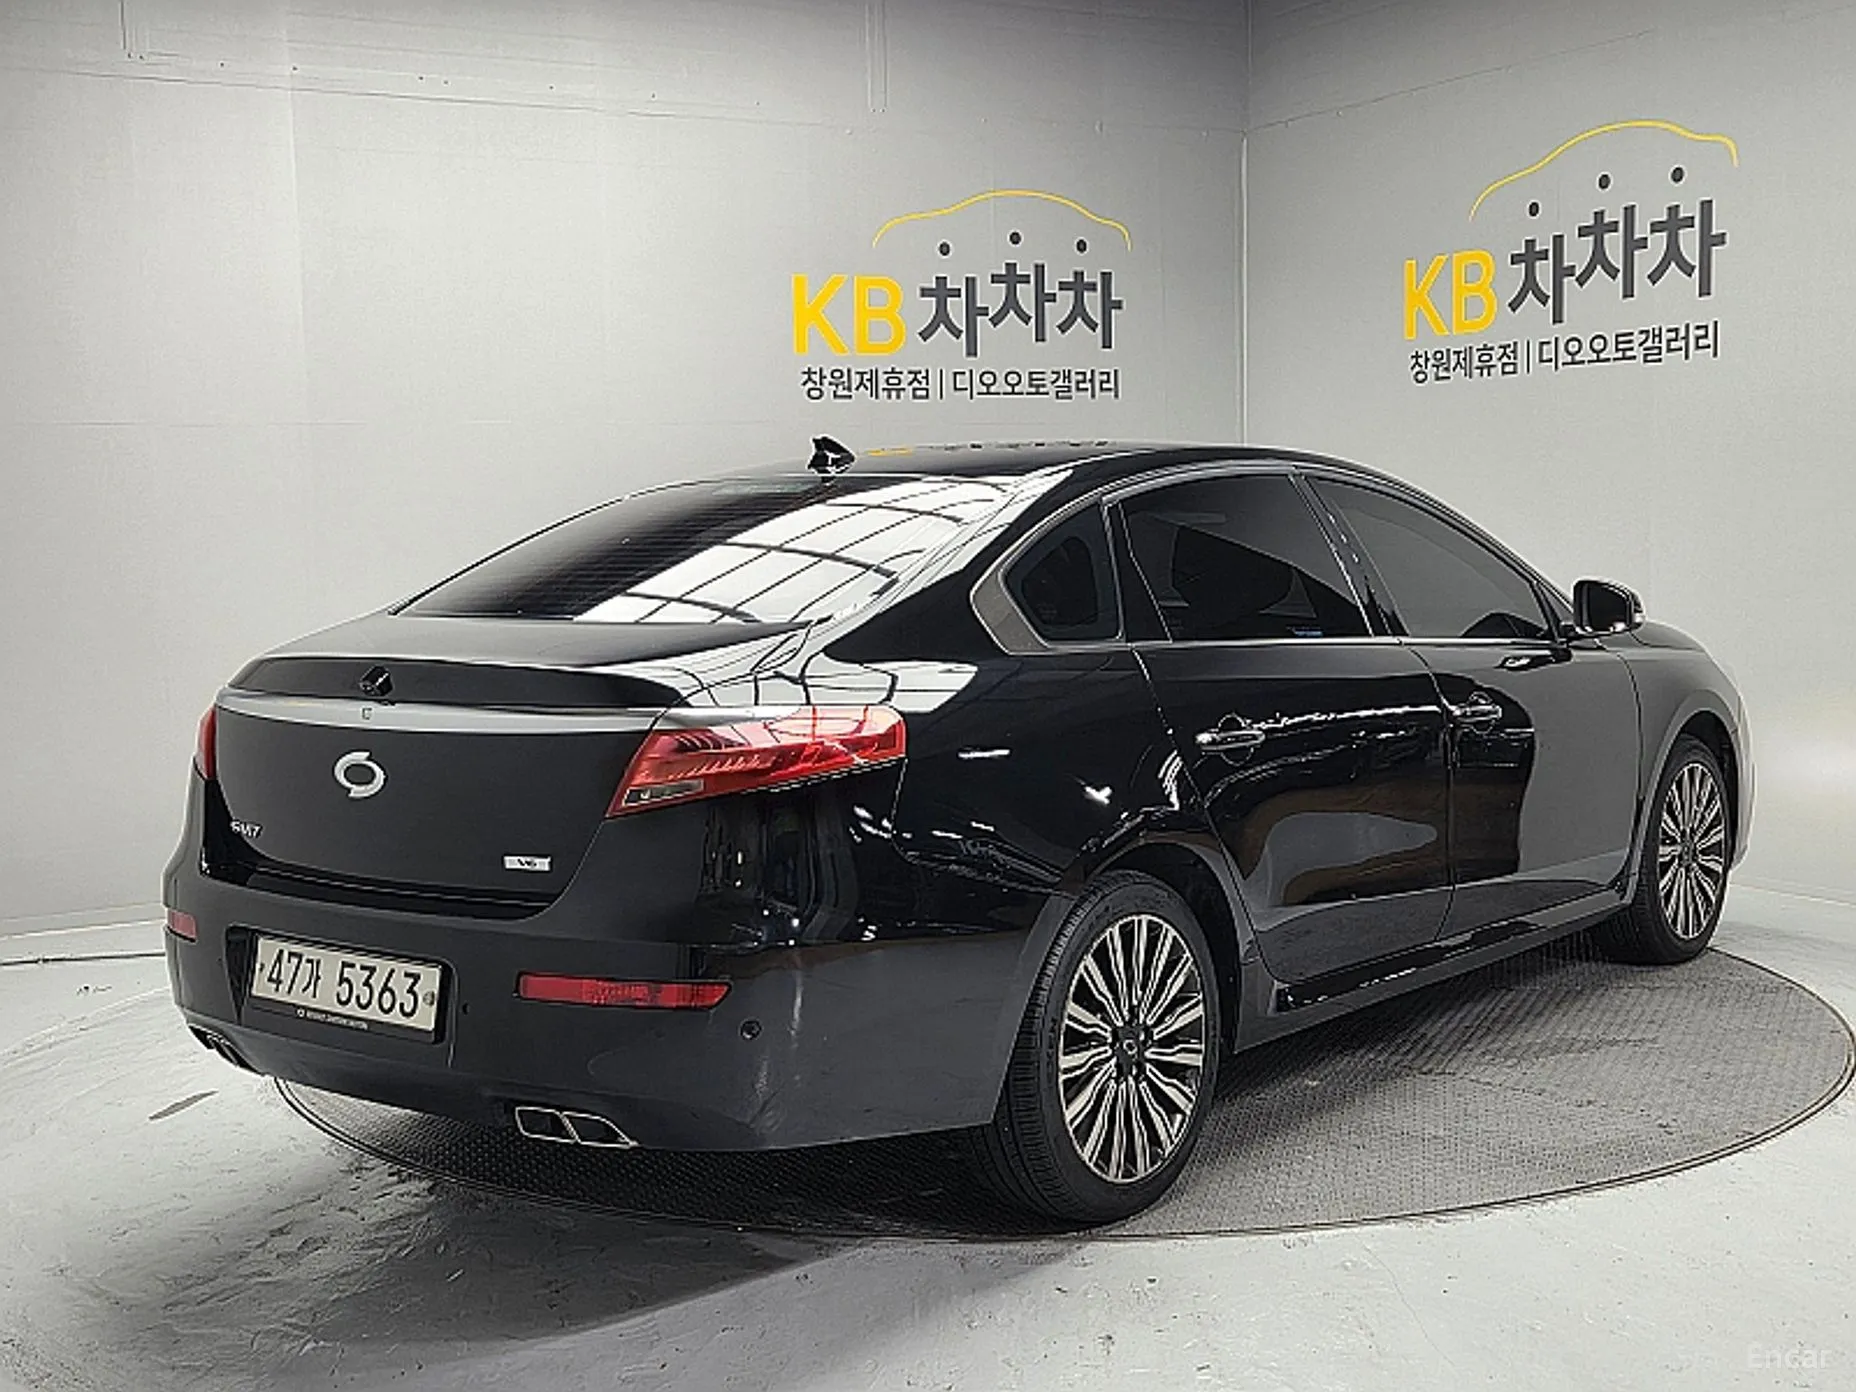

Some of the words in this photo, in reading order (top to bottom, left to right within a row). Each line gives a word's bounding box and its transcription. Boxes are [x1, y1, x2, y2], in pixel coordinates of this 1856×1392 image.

[1403, 250, 1497, 340] KB
[1508, 199, 1727, 325] 차차차
[791, 274, 906, 355] KB
[918, 262, 1123, 358] 차차차
[800, 366, 930, 400] 창원제휴점
[953, 369, 1120, 400] 디오오토갤러리
[1410, 341, 1518, 384] 창원제휴점
[1538, 320, 1719, 372] 디오오토갤러리
[267, 949, 321, 999] 47가
[336, 961, 421, 1018] 5363
